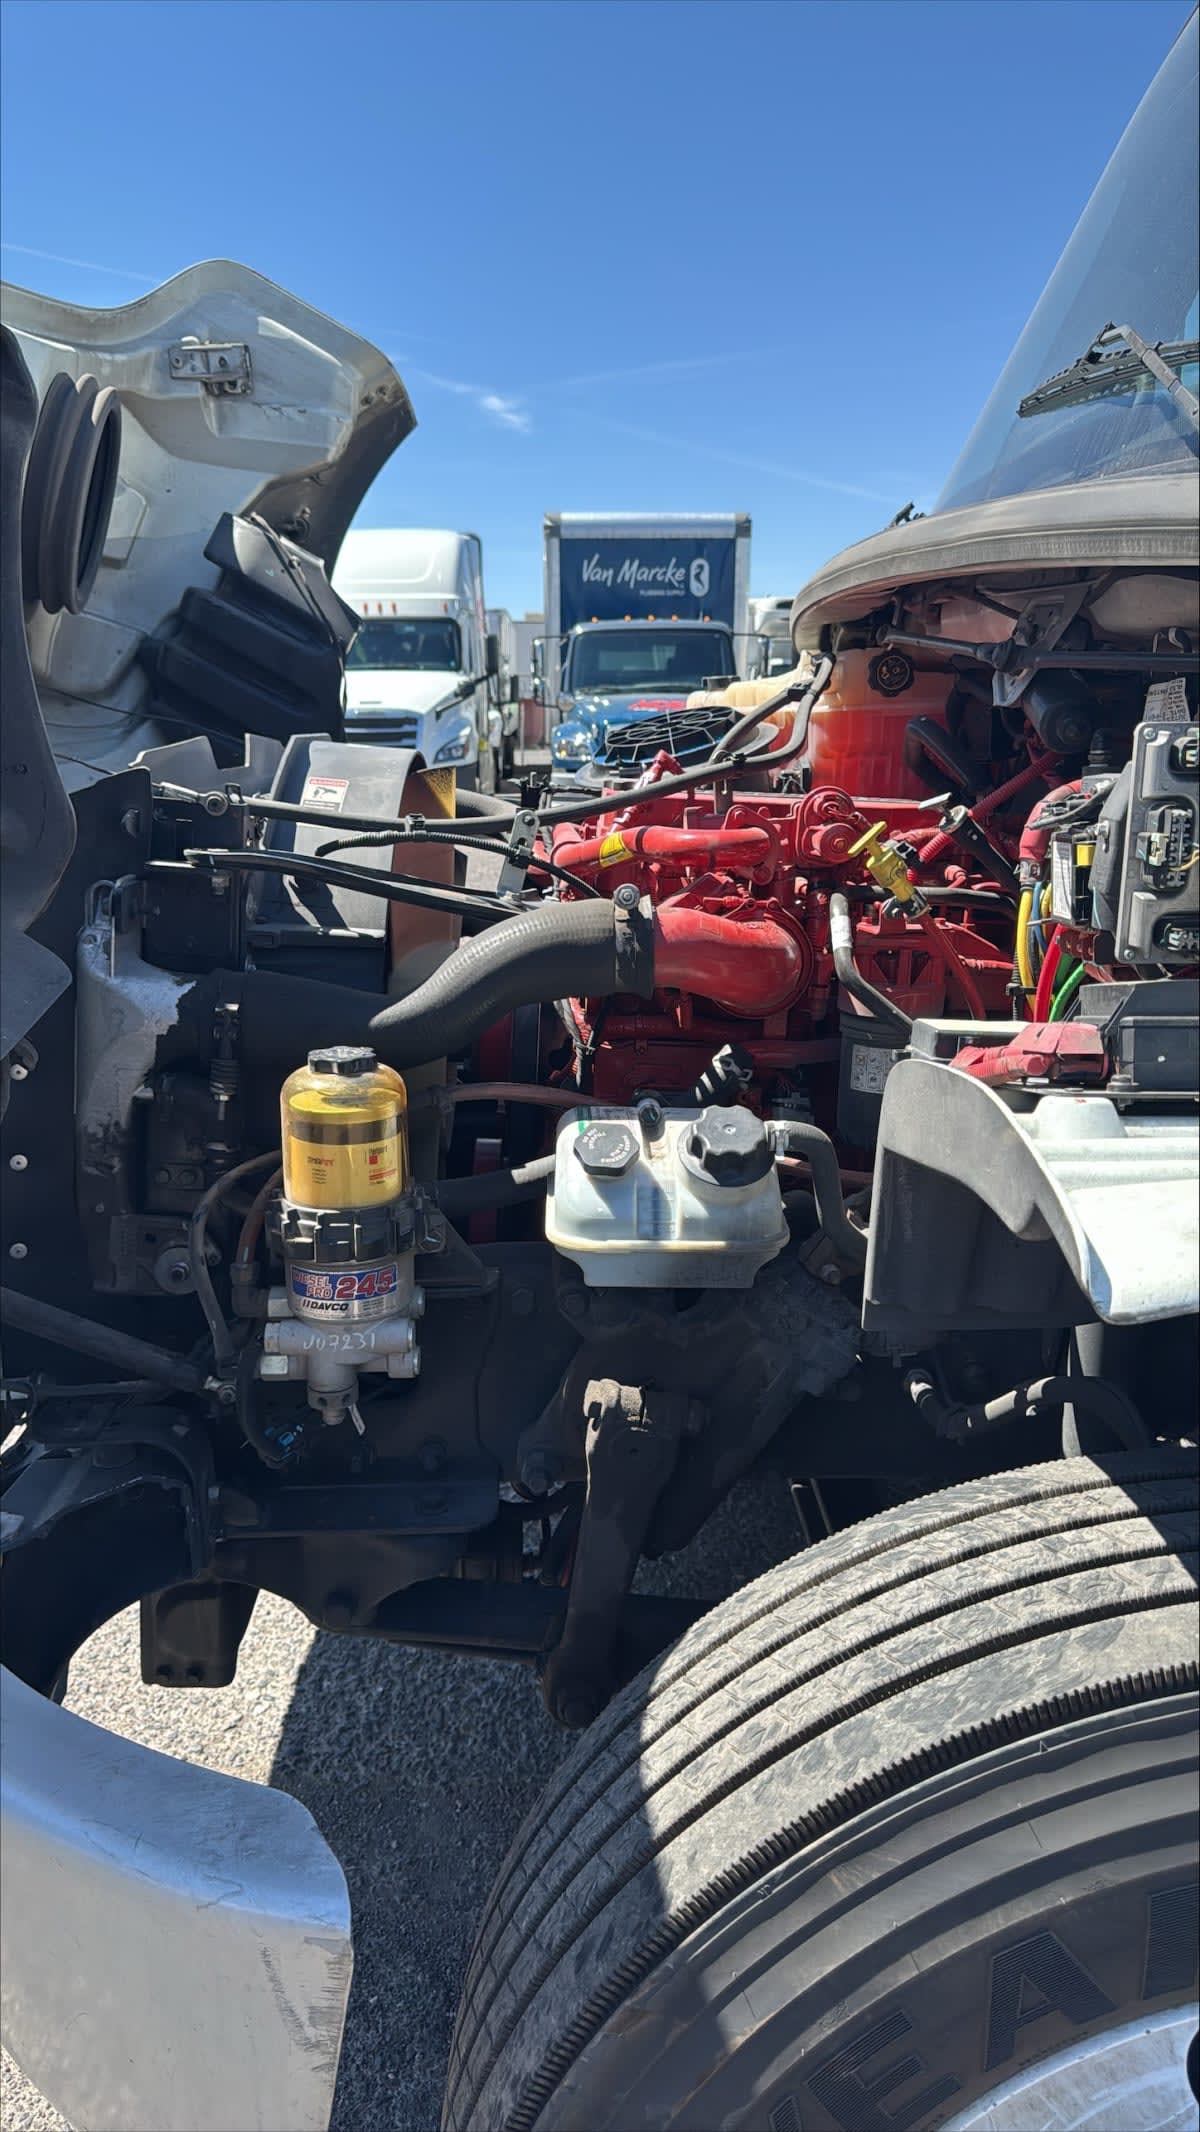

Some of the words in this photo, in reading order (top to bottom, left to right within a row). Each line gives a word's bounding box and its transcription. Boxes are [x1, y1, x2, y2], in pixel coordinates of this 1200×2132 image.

[582, 552, 614, 587] Van
[617, 556, 685, 589] Marcke
[292, 1269, 332, 1287] DIESEL
[335, 1269, 394, 1300] 245
[306, 1286, 333, 1299] PRO
